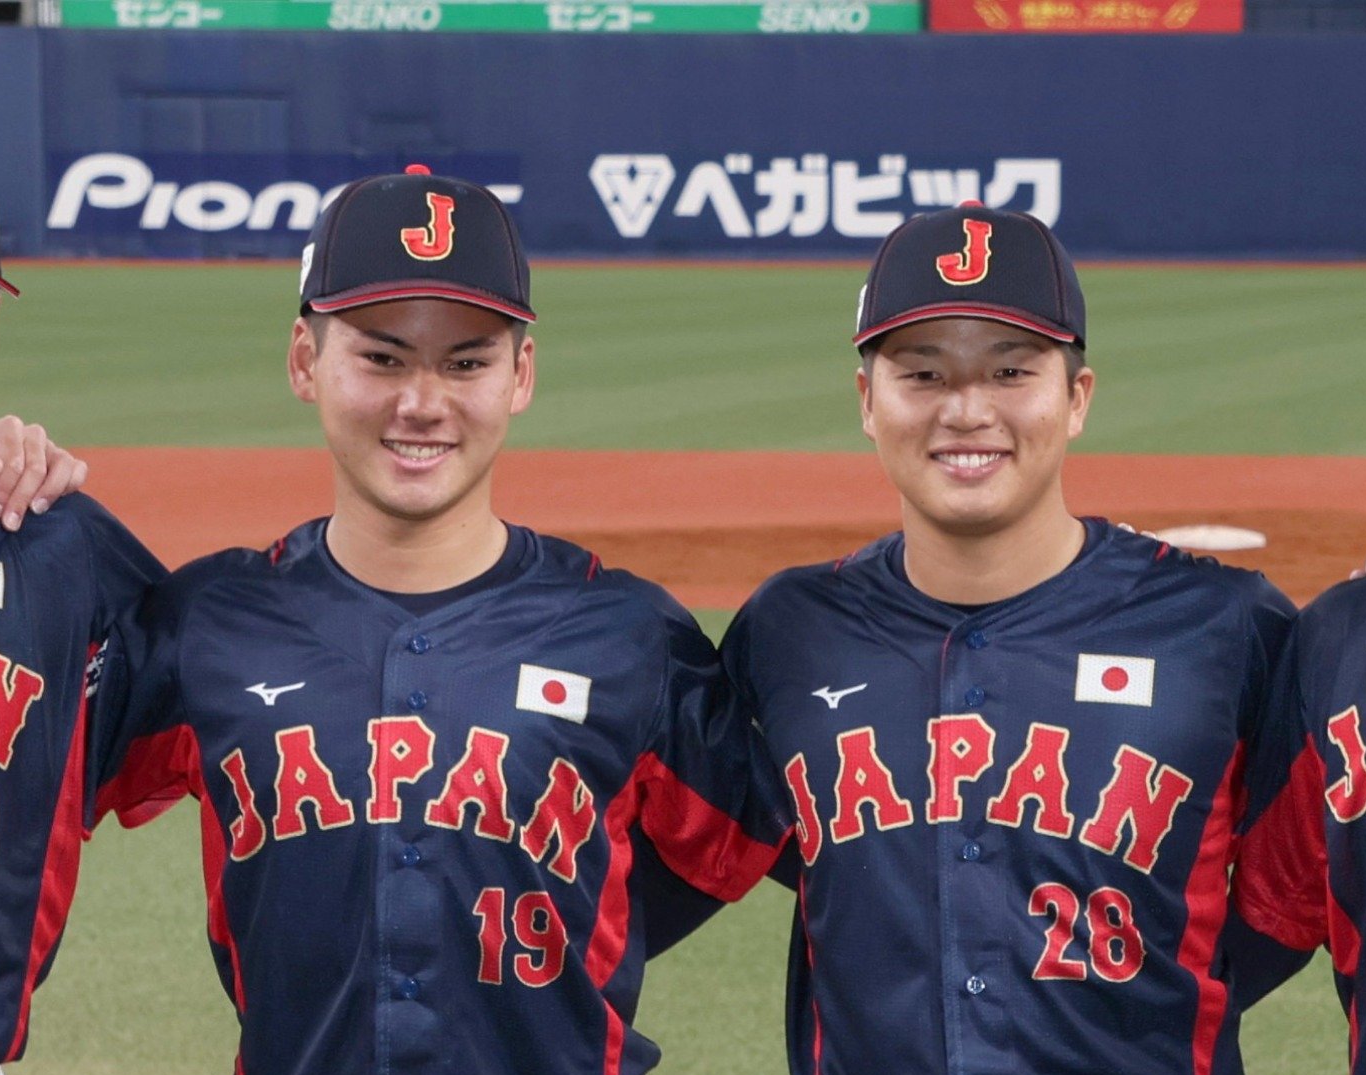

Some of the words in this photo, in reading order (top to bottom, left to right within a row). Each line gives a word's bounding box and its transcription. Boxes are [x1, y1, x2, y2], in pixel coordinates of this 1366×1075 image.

[115, 2, 224, 28] センコー
[329, 2, 441, 31] SENKO
[546, 3, 655, 31] センコー
[759, 3, 870, 33] SENKO
[400, 192, 455, 260] J
[673, 153, 1062, 238] ベガビック
[936, 218, 992, 285] J
[220, 715, 596, 884] JAPAN
[784, 713, 1193, 874] JAPAN
[472, 887, 569, 987] 19
[1028, 882, 1145, 983] 28
